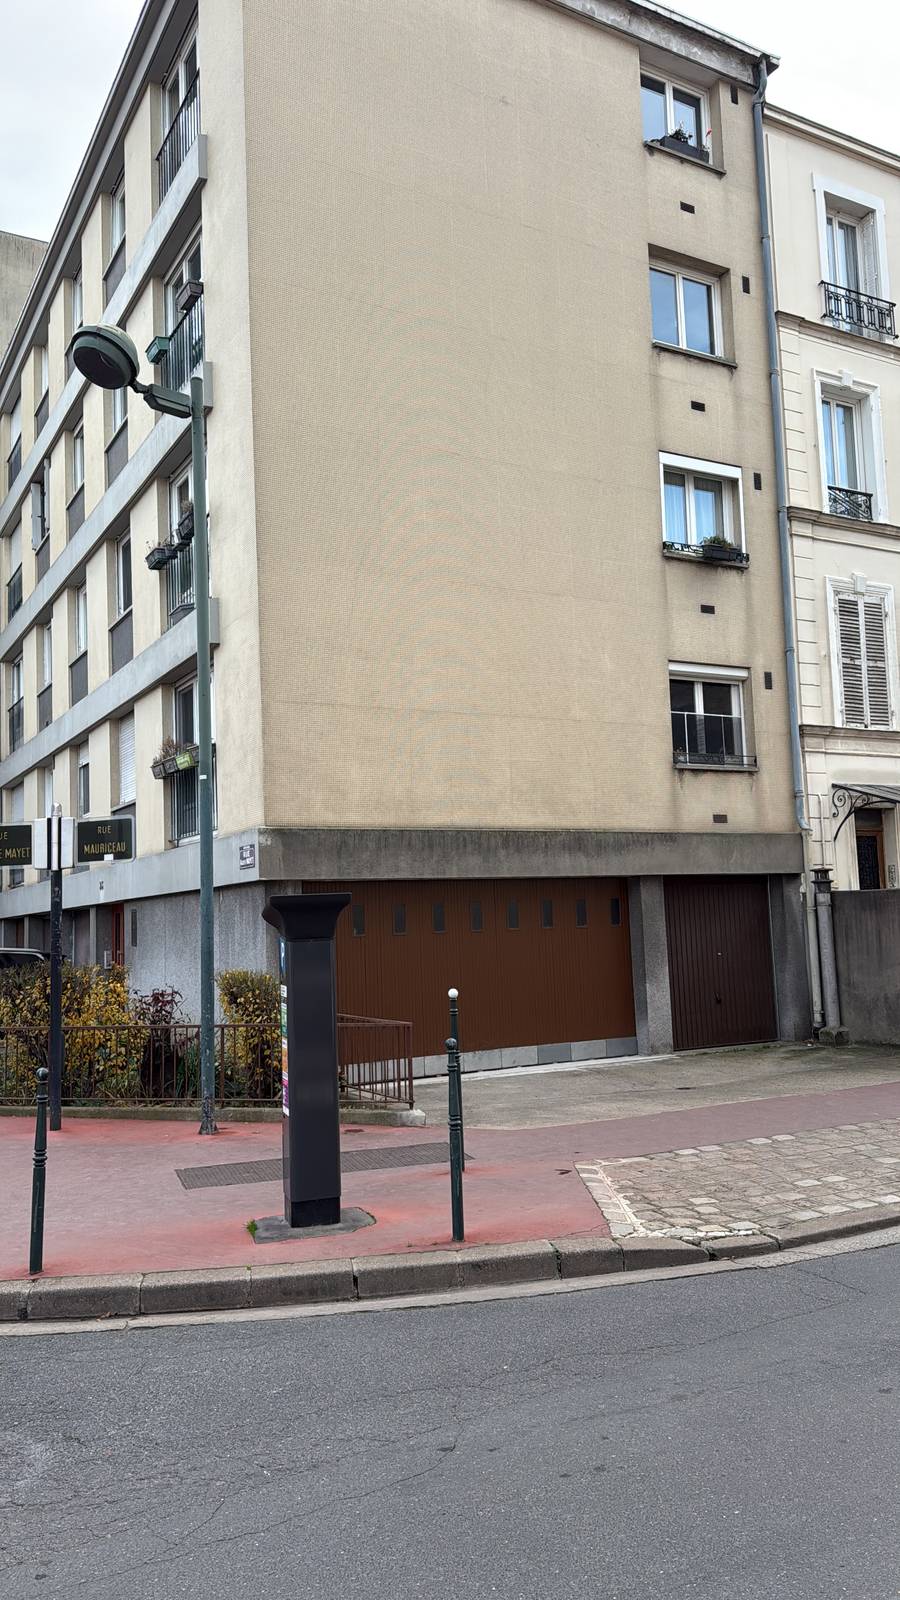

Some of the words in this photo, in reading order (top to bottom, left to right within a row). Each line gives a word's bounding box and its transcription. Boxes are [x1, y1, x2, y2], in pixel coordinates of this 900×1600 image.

[97, 825, 112, 834] RUE
[5, 847, 30, 859] MAYET
[83, 841, 126, 855] MAURICEAU
